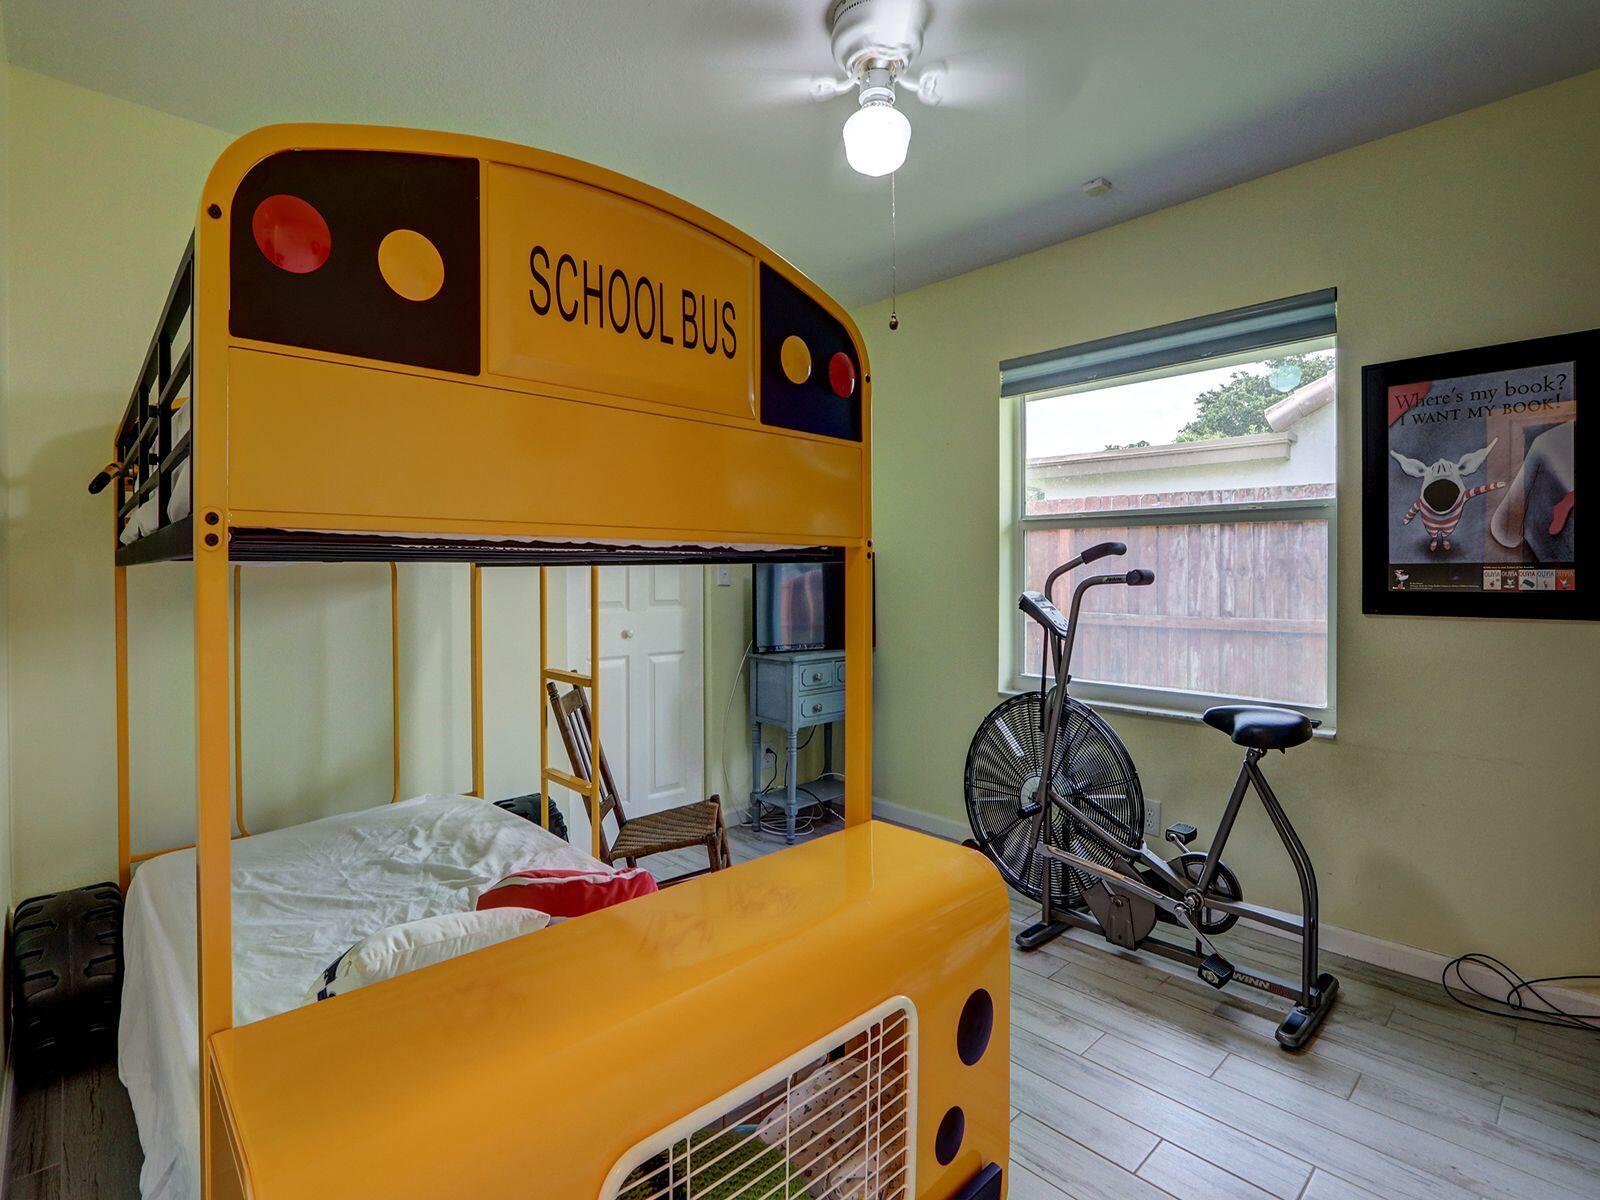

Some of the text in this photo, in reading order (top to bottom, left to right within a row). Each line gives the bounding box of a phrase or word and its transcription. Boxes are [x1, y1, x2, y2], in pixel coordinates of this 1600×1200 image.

[529, 245, 737, 359] SCHOOL BUS
[1394, 373, 1567, 409] Where's my book?
[1399, 393, 1561, 426] I WANT MY BOOK!
[1233, 971, 1270, 989] WINN
